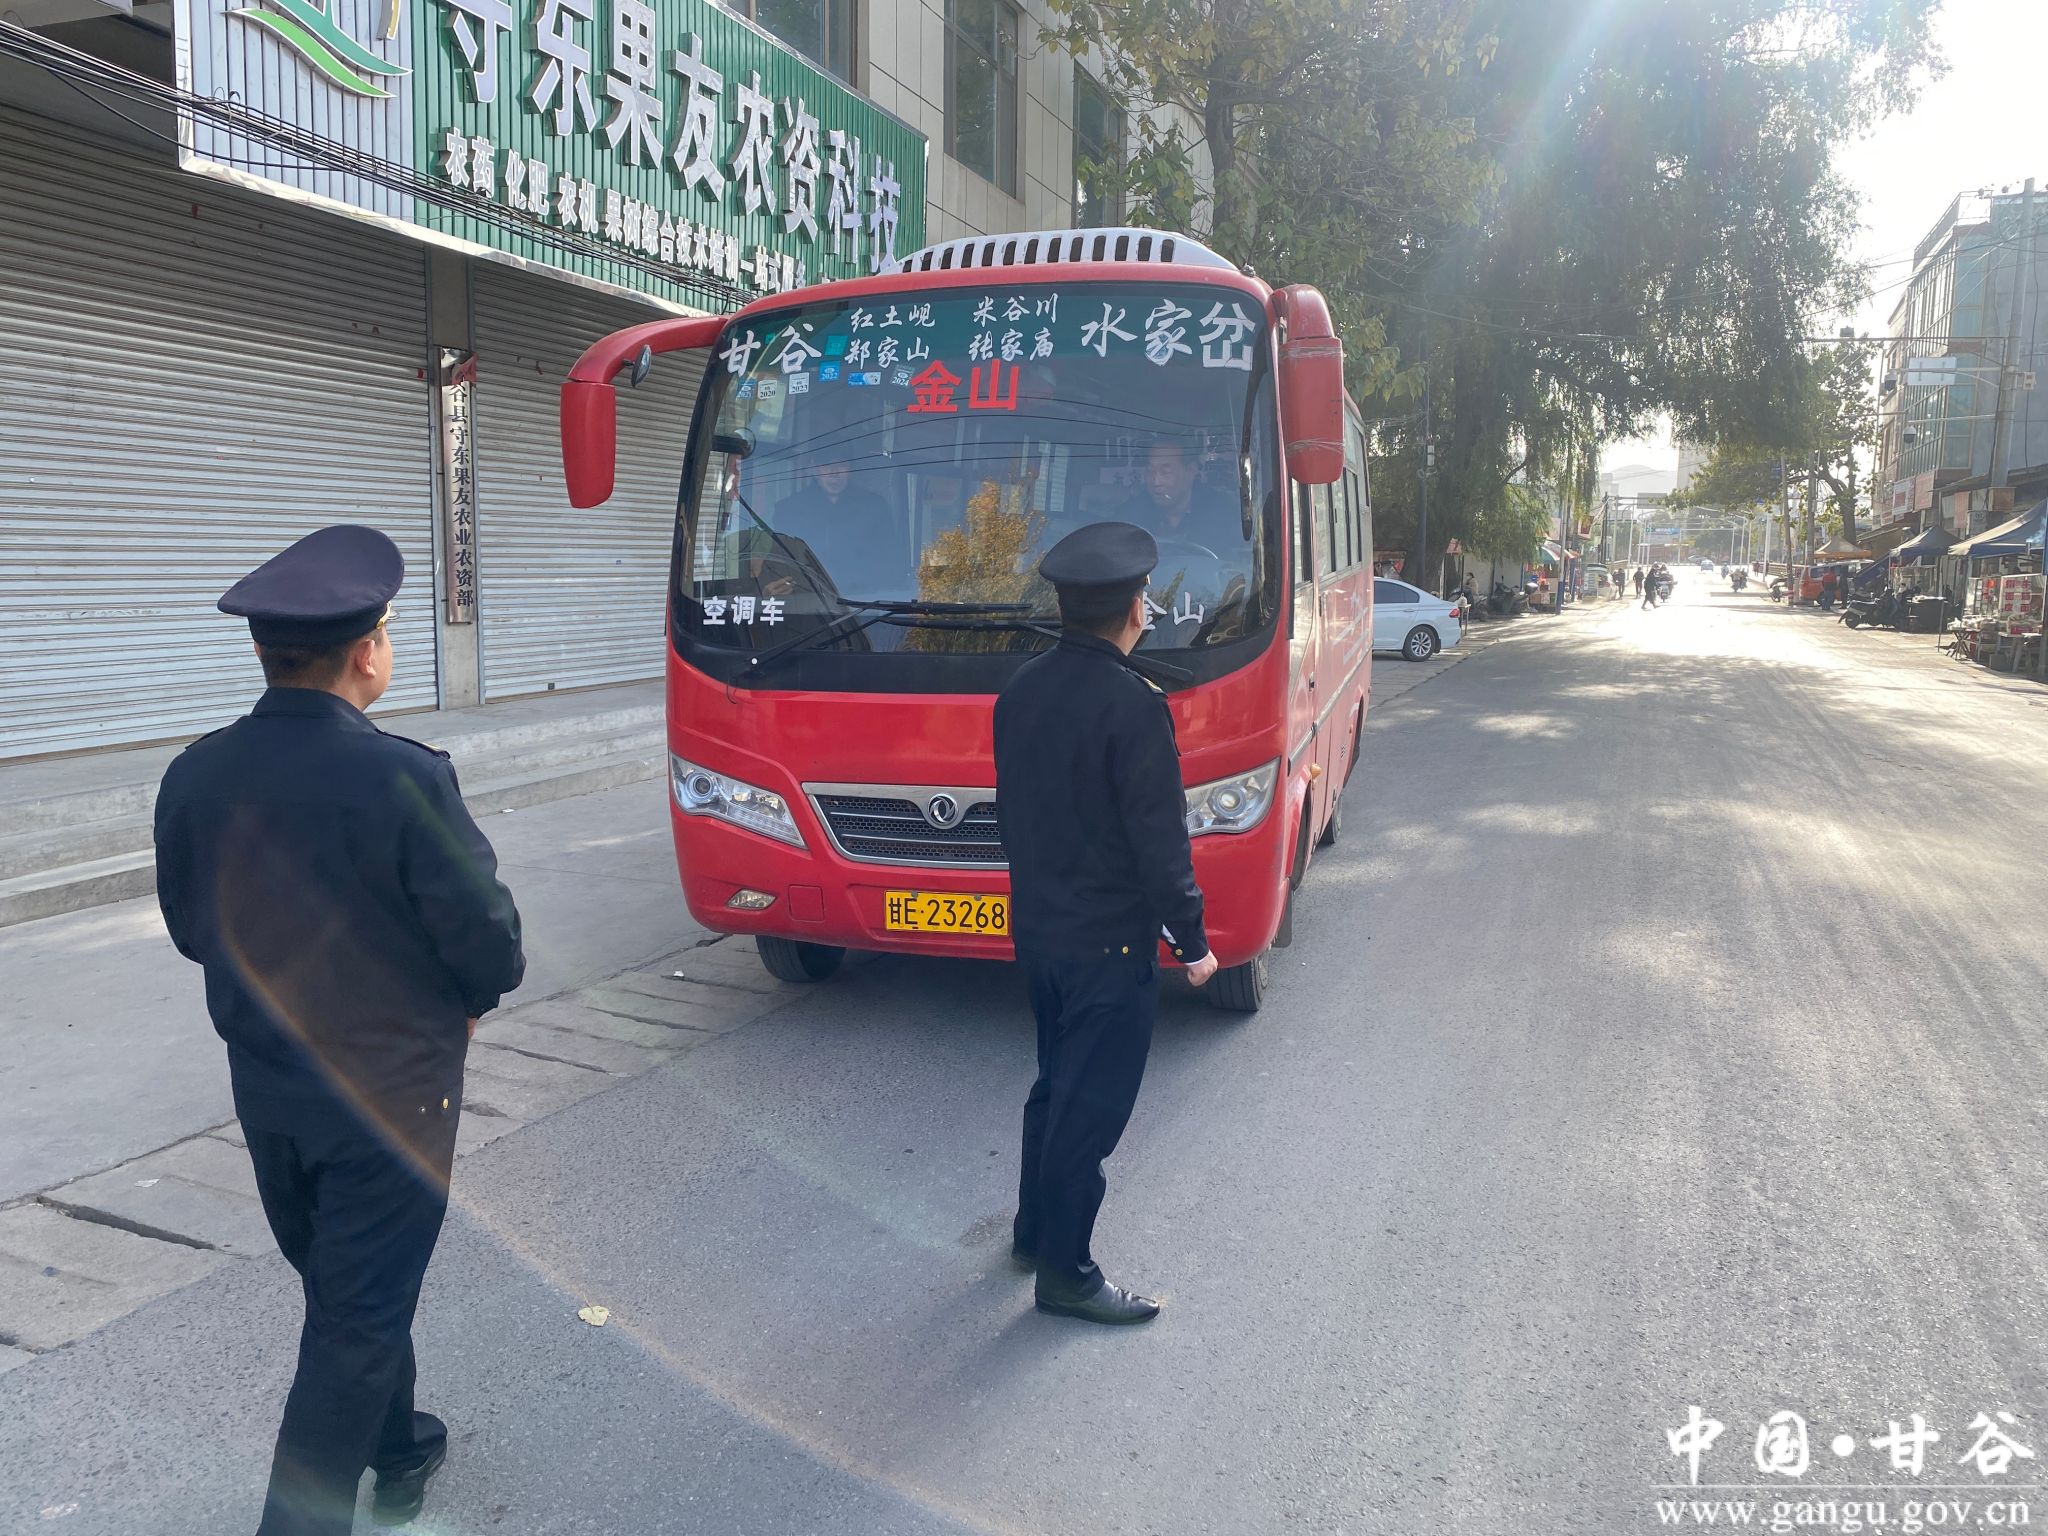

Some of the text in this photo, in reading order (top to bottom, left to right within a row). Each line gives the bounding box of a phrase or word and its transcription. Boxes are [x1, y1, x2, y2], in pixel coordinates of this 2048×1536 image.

[445, 126, 495, 199] 农药
[505, 148, 550, 216] 化肥
[557, 171, 599, 234] 农机
[851, 293, 1058, 333] 红土岘 米谷川
[719, 298, 1256, 375] 甘谷 水家岔
[844, 336, 930, 369] 郑家山
[968, 327, 1054, 362] 张家庙
[760, 390, 776, 398] 2020
[791, 384, 808, 393] 2023
[907, 358, 1020, 413] 金山
[703, 595, 785, 626] 空调车
